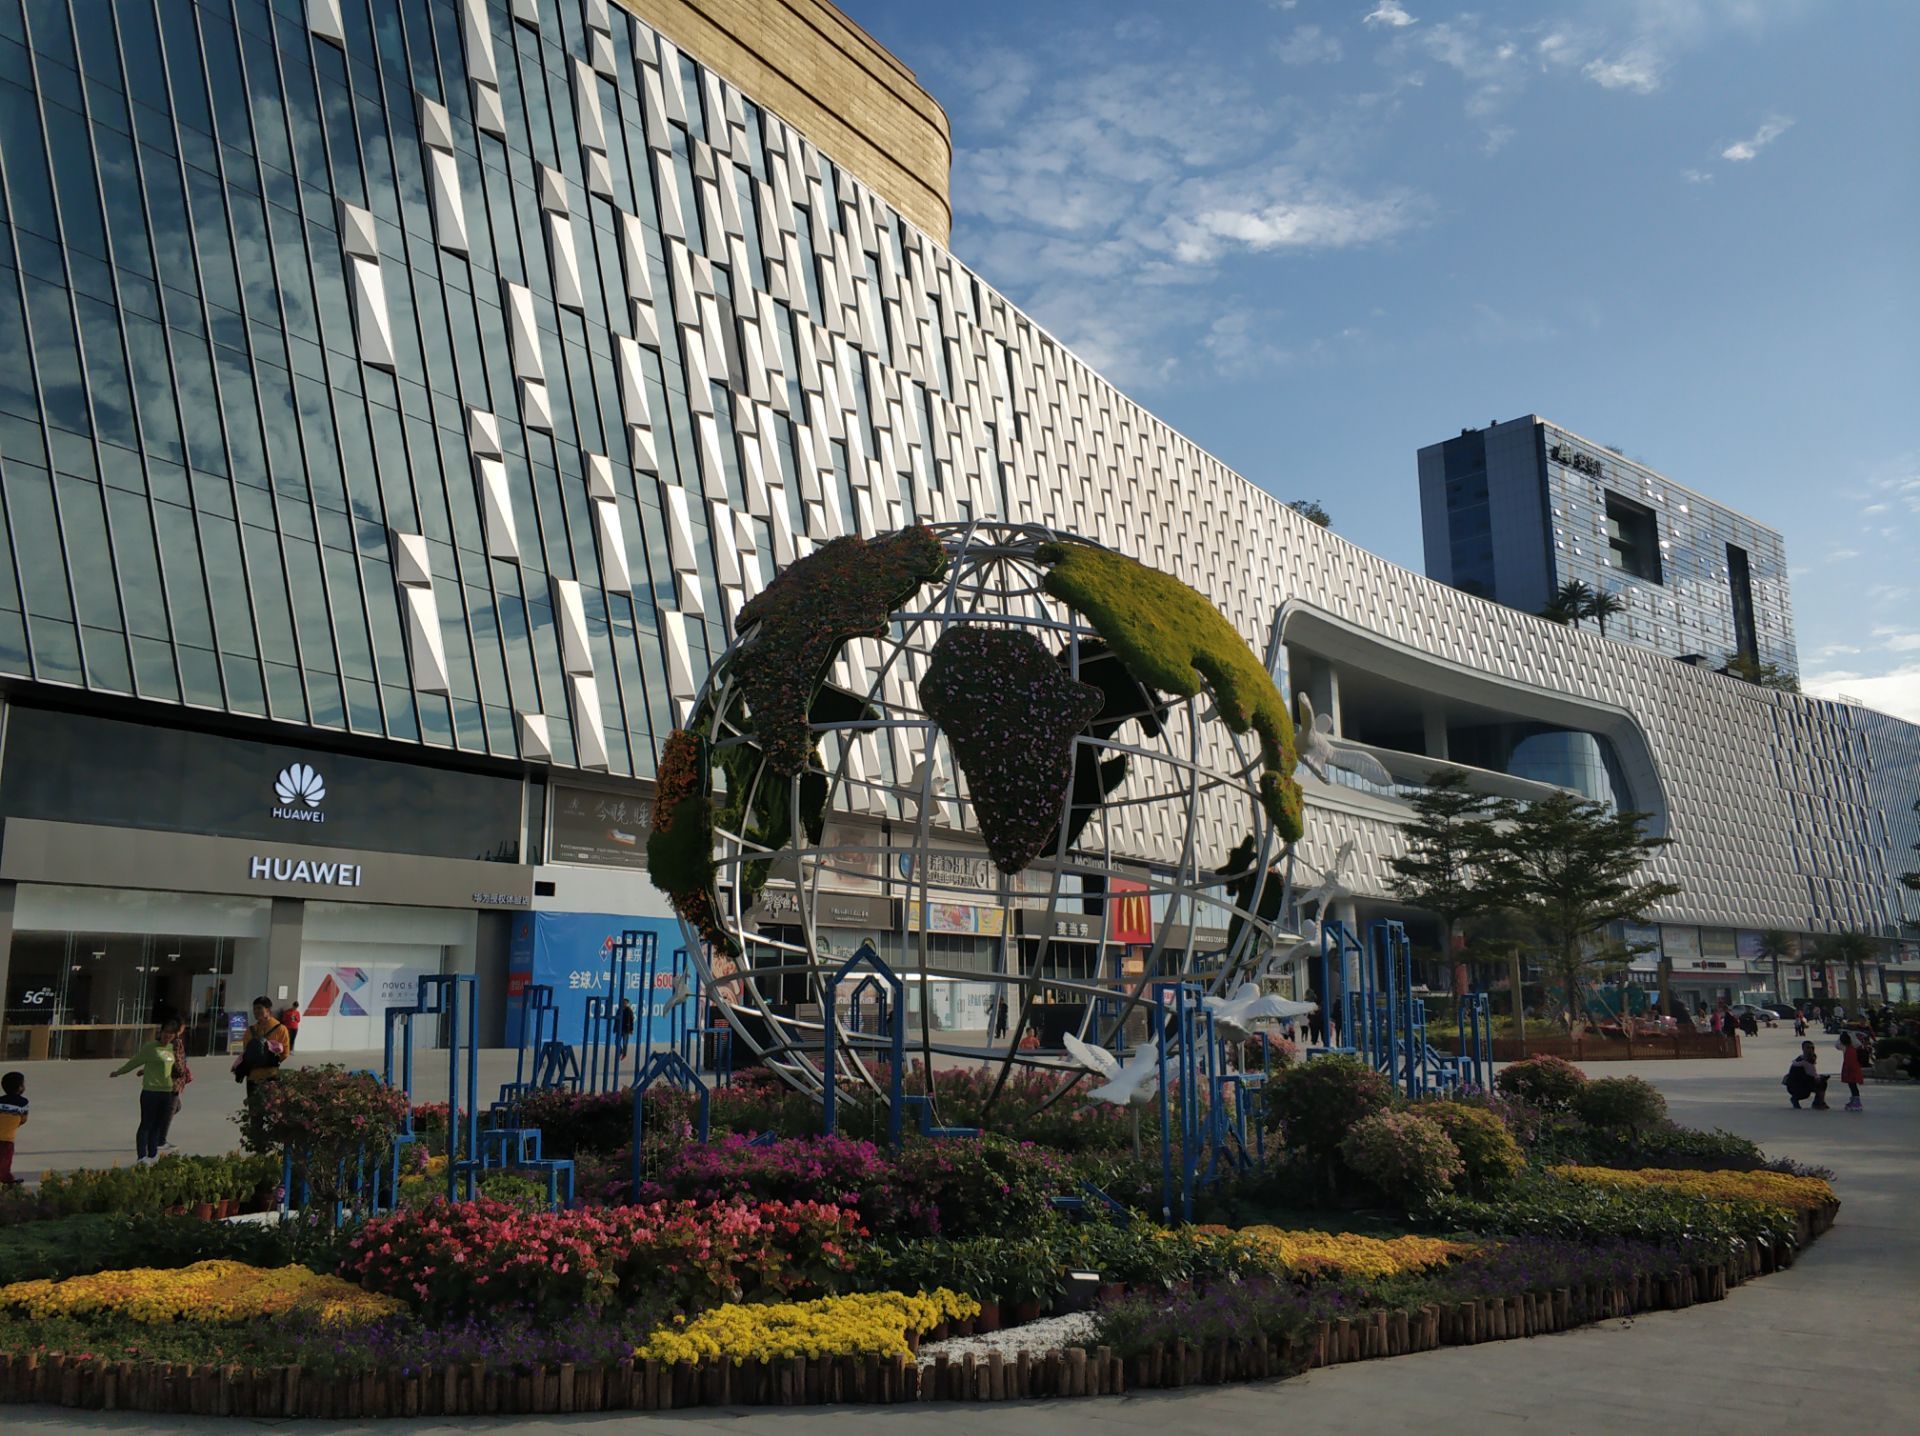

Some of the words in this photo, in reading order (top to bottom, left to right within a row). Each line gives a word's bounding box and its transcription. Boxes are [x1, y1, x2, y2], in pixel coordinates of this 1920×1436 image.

[272, 807, 325, 823] HUAWEI
[250, 855, 361, 887] HUAWEI
[382, 982, 405, 990] nova
[22, 991, 45, 1004] 5G
